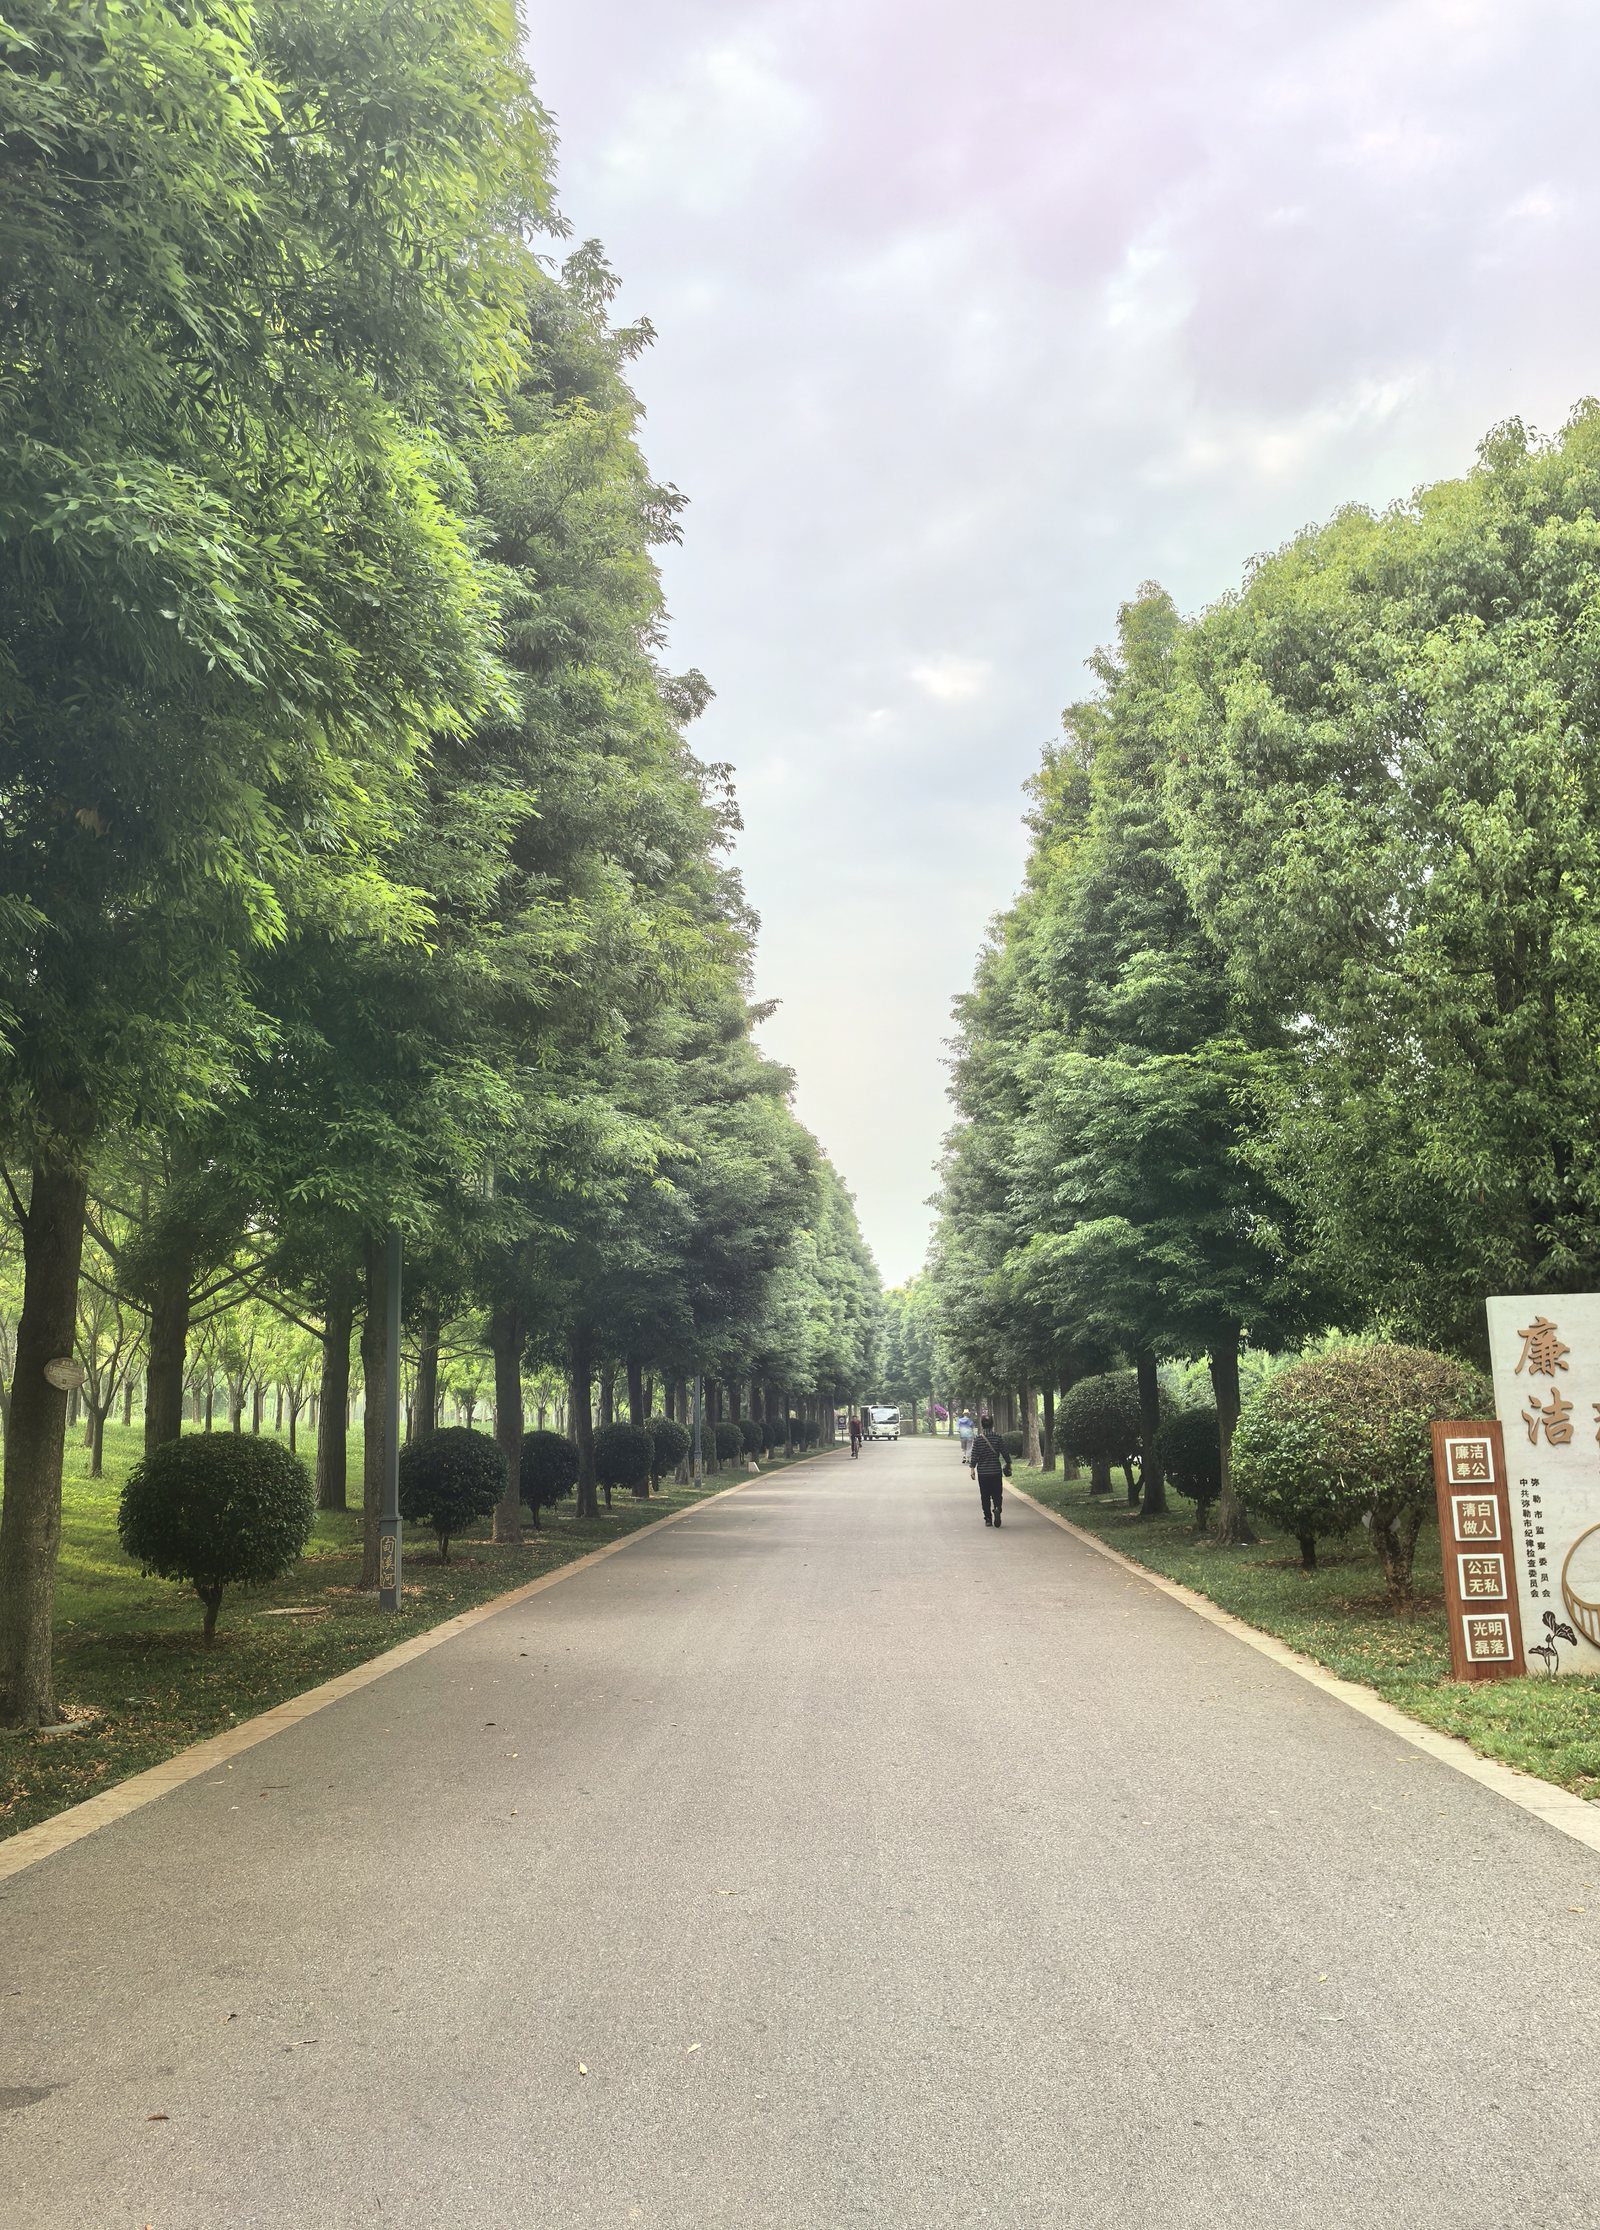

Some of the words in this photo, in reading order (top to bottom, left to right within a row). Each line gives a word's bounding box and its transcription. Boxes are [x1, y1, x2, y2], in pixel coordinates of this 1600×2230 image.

[1455, 1444, 1484, 1460] 廉洁
[1456, 1462, 1486, 1477] 奉公
[1462, 1502, 1491, 1517] 清白
[1463, 1519, 1493, 1535] 做人
[1531, 1478, 1550, 1598] 弥勒市监察委员会
[1467, 1560, 1498, 1575] 公正
[1469, 1578, 1500, 1593] 无私
[1473, 1621, 1503, 1636] 光明
[1475, 1639, 1505, 1655] 磊落
